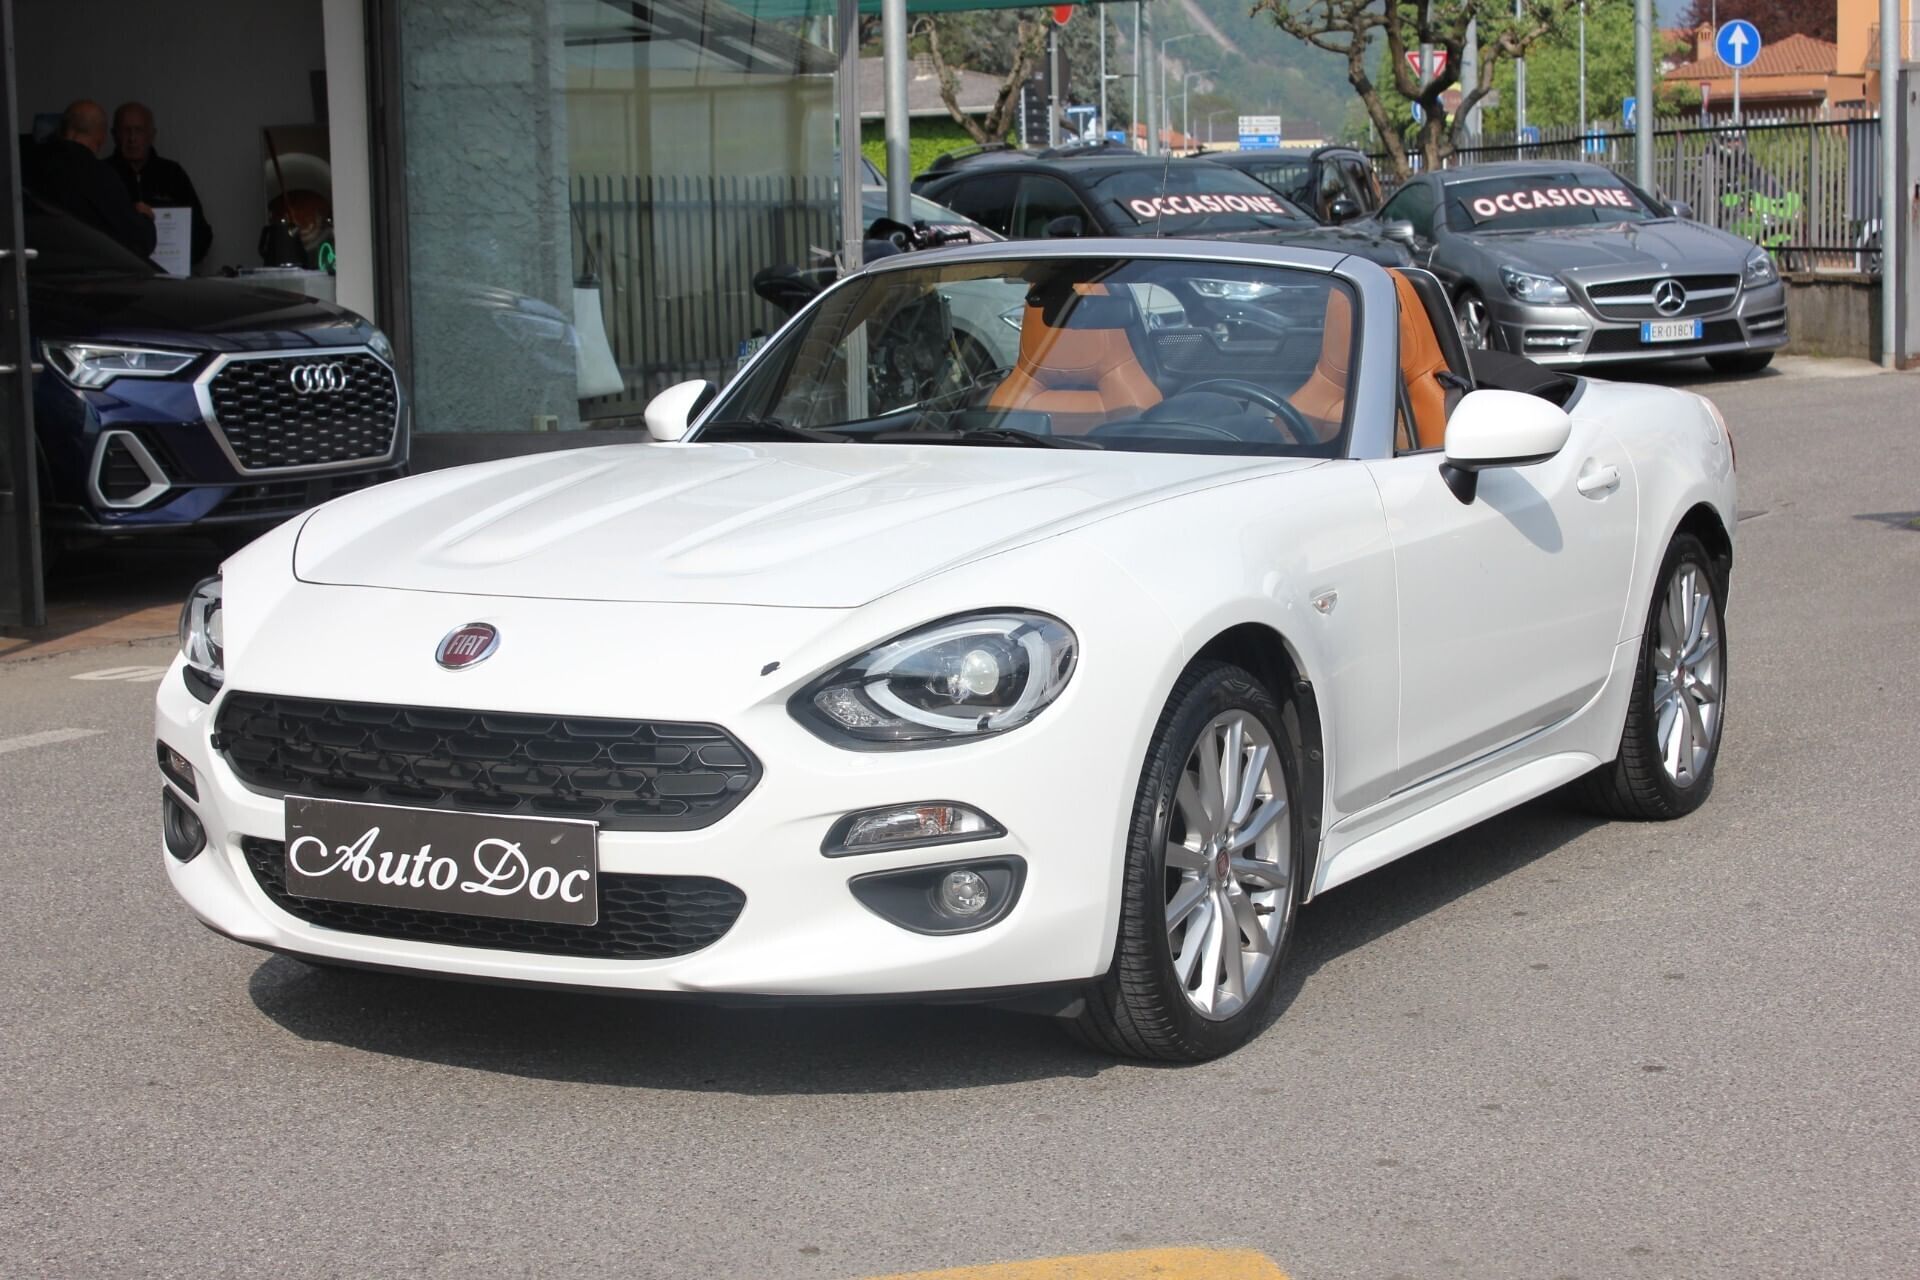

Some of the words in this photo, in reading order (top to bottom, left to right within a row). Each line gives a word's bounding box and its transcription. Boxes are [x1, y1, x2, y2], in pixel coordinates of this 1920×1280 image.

[1131, 194, 1284, 217] OCCASIONE
[1473, 188, 1633, 216] OCCASIONE
[446, 634, 489, 656] FIAT
[289, 826, 458, 891] Auto
[460, 837, 590, 903] Doc
